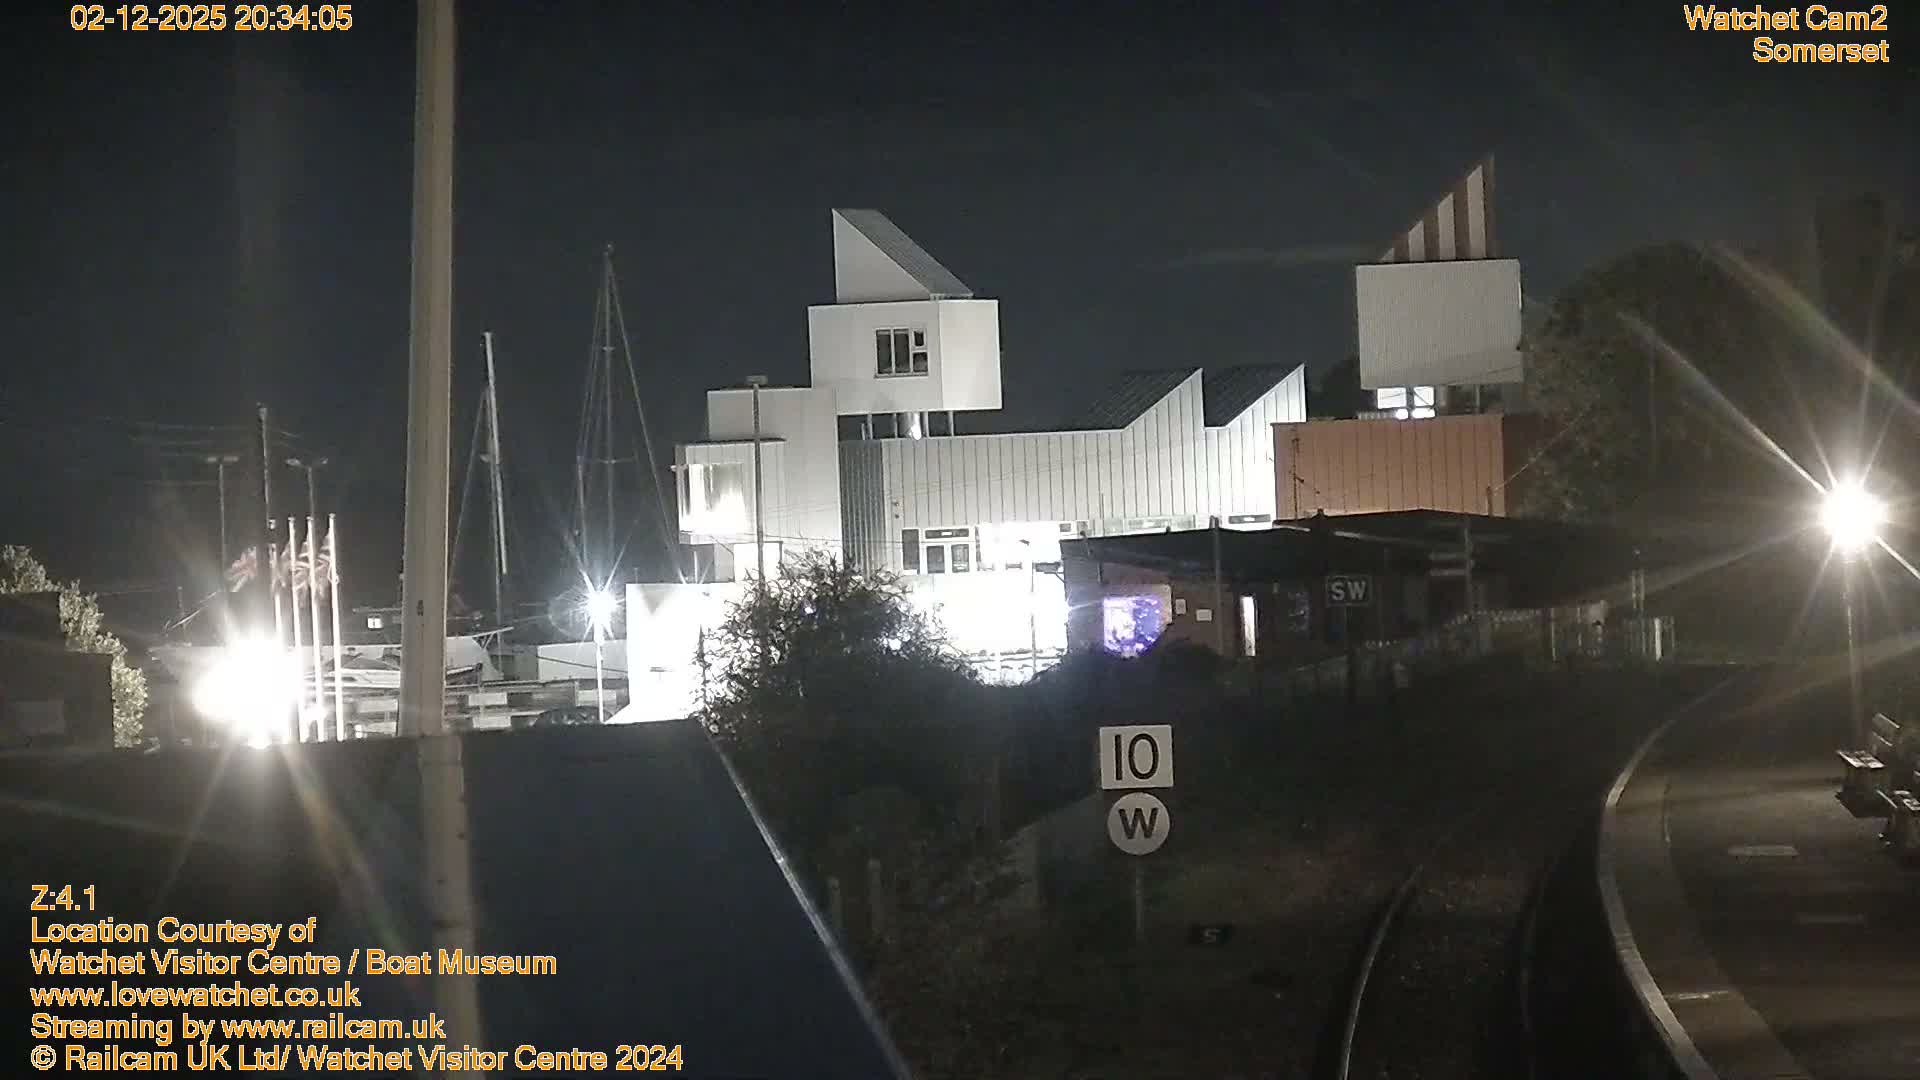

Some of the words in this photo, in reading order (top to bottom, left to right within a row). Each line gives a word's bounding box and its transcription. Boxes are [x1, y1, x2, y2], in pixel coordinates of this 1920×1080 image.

[1331, 580, 1366, 601] SW
[1114, 733, 1159, 781] 10
[1118, 807, 1159, 839] W
